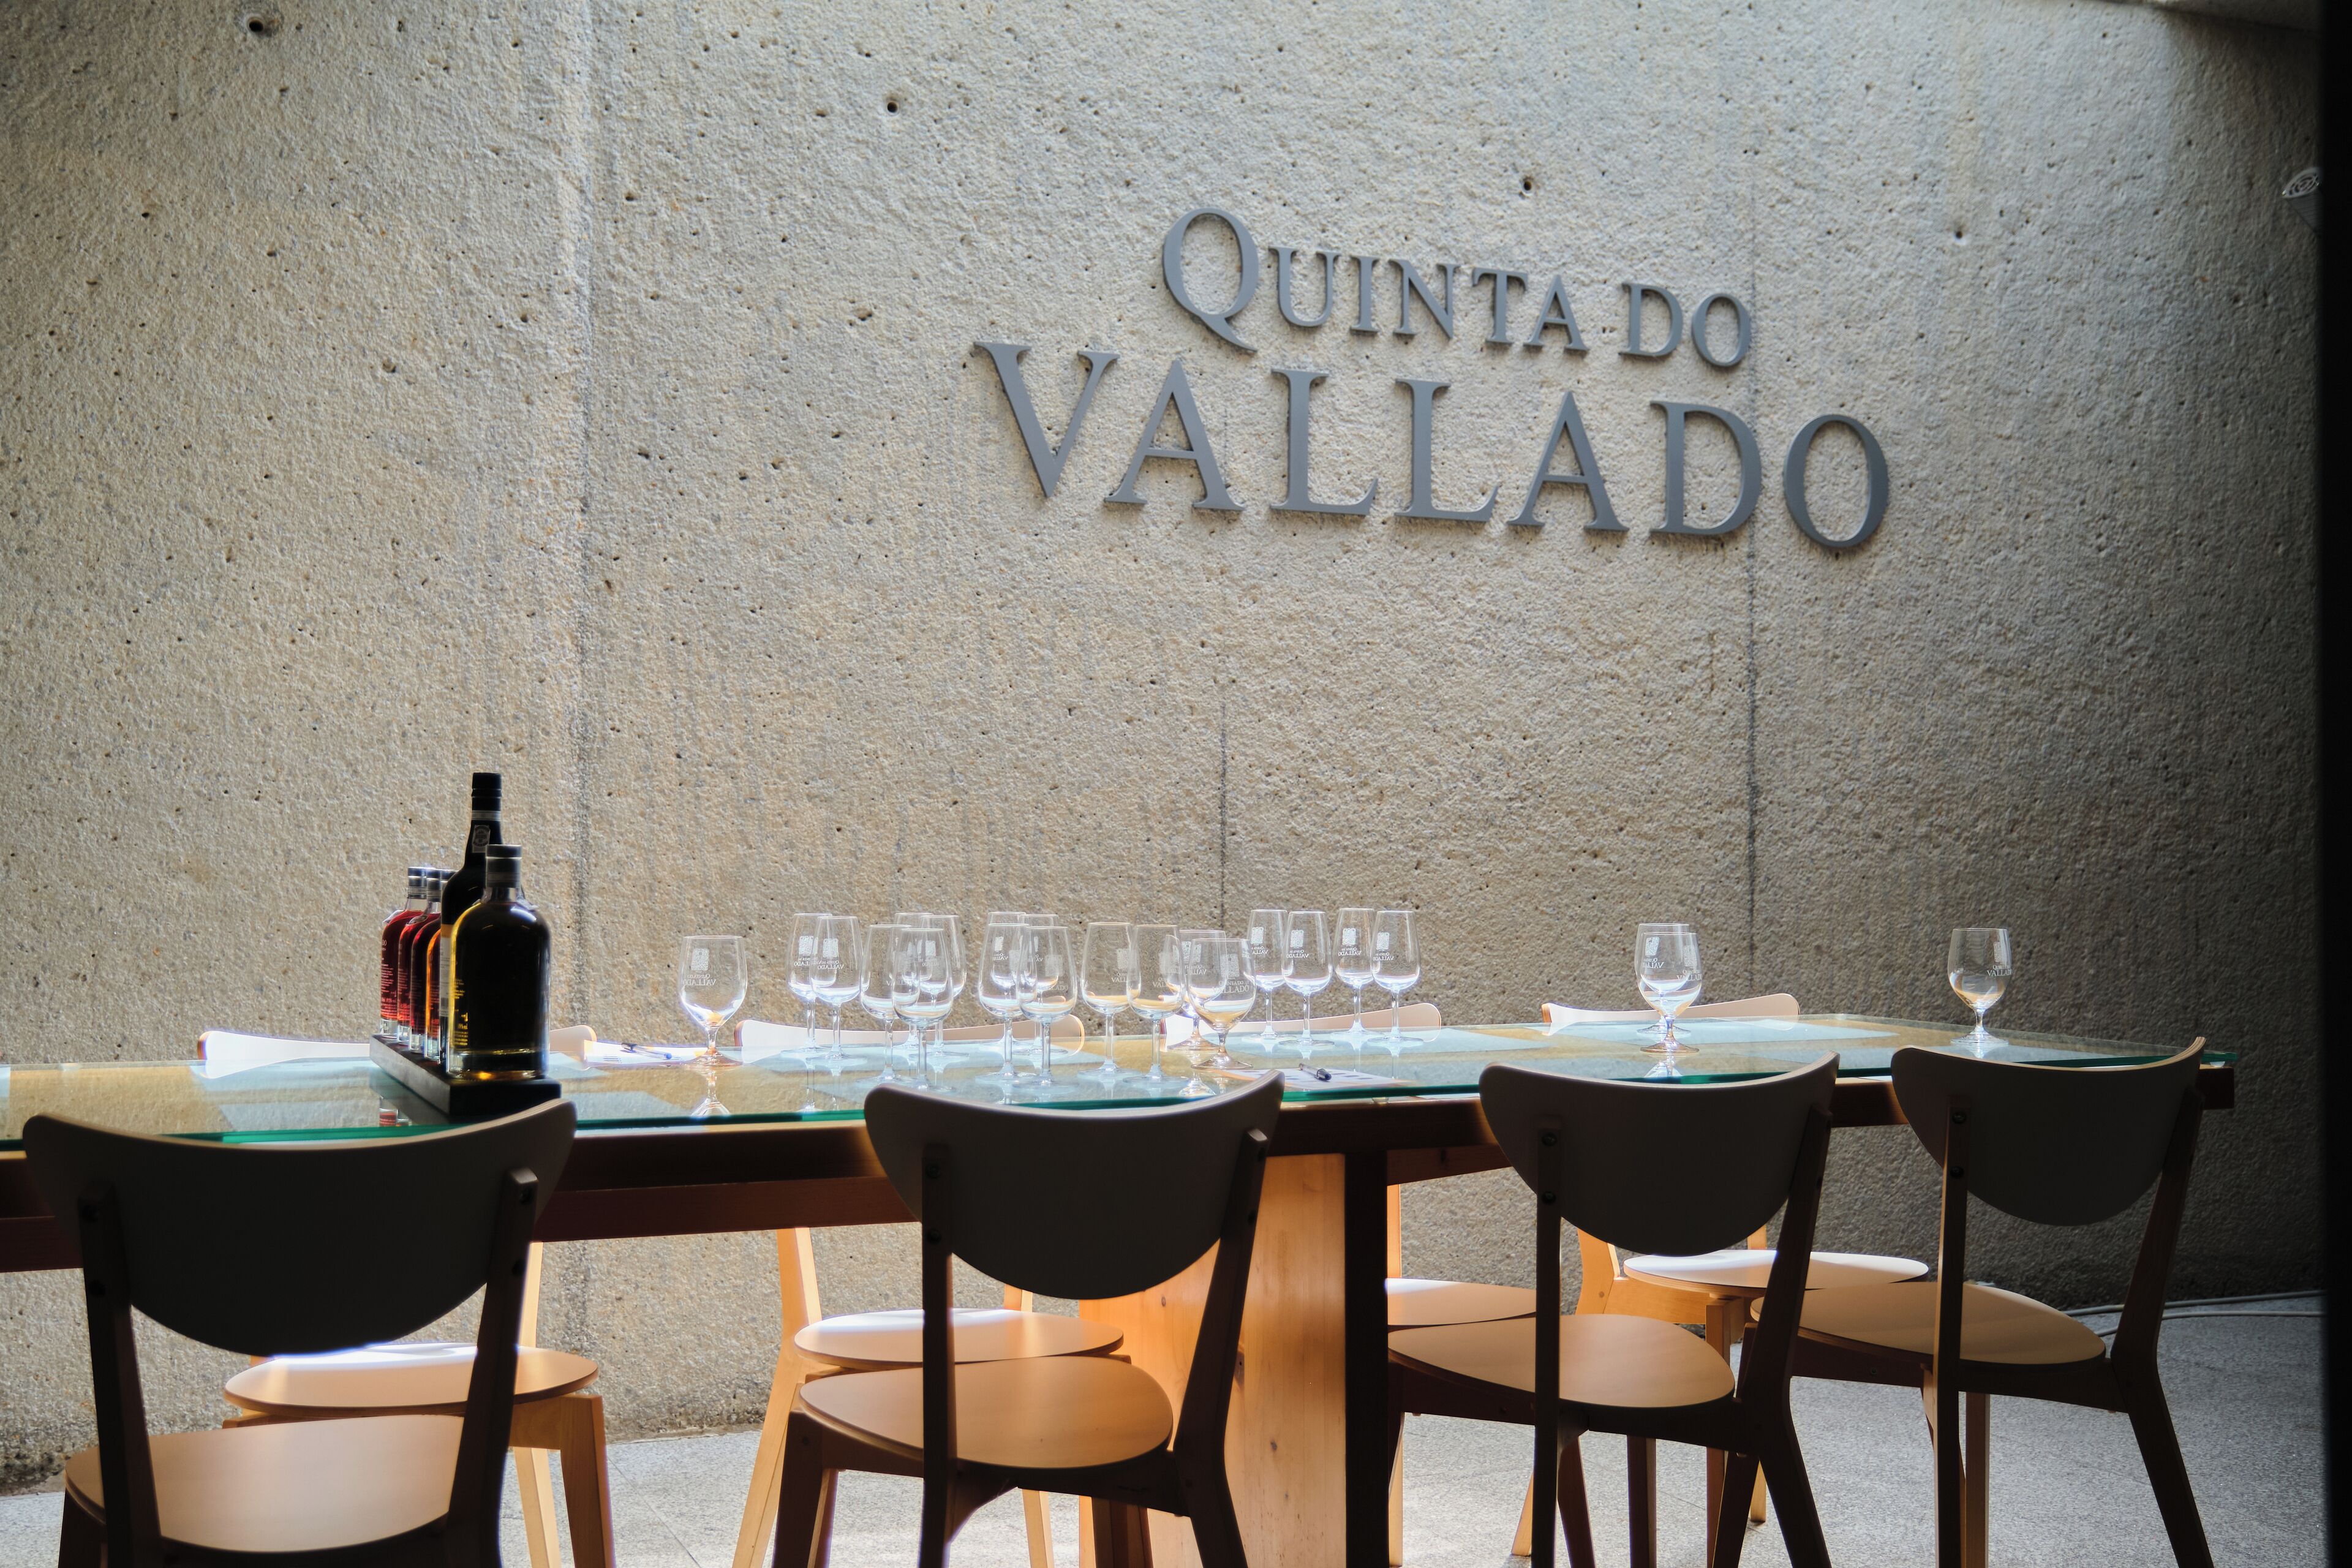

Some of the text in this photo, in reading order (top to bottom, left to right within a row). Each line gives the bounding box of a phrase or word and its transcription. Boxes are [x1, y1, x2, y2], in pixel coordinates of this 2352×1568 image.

[1162, 207, 1751, 368] QUINTA DO
[974, 341, 1889, 549] VALLADO
